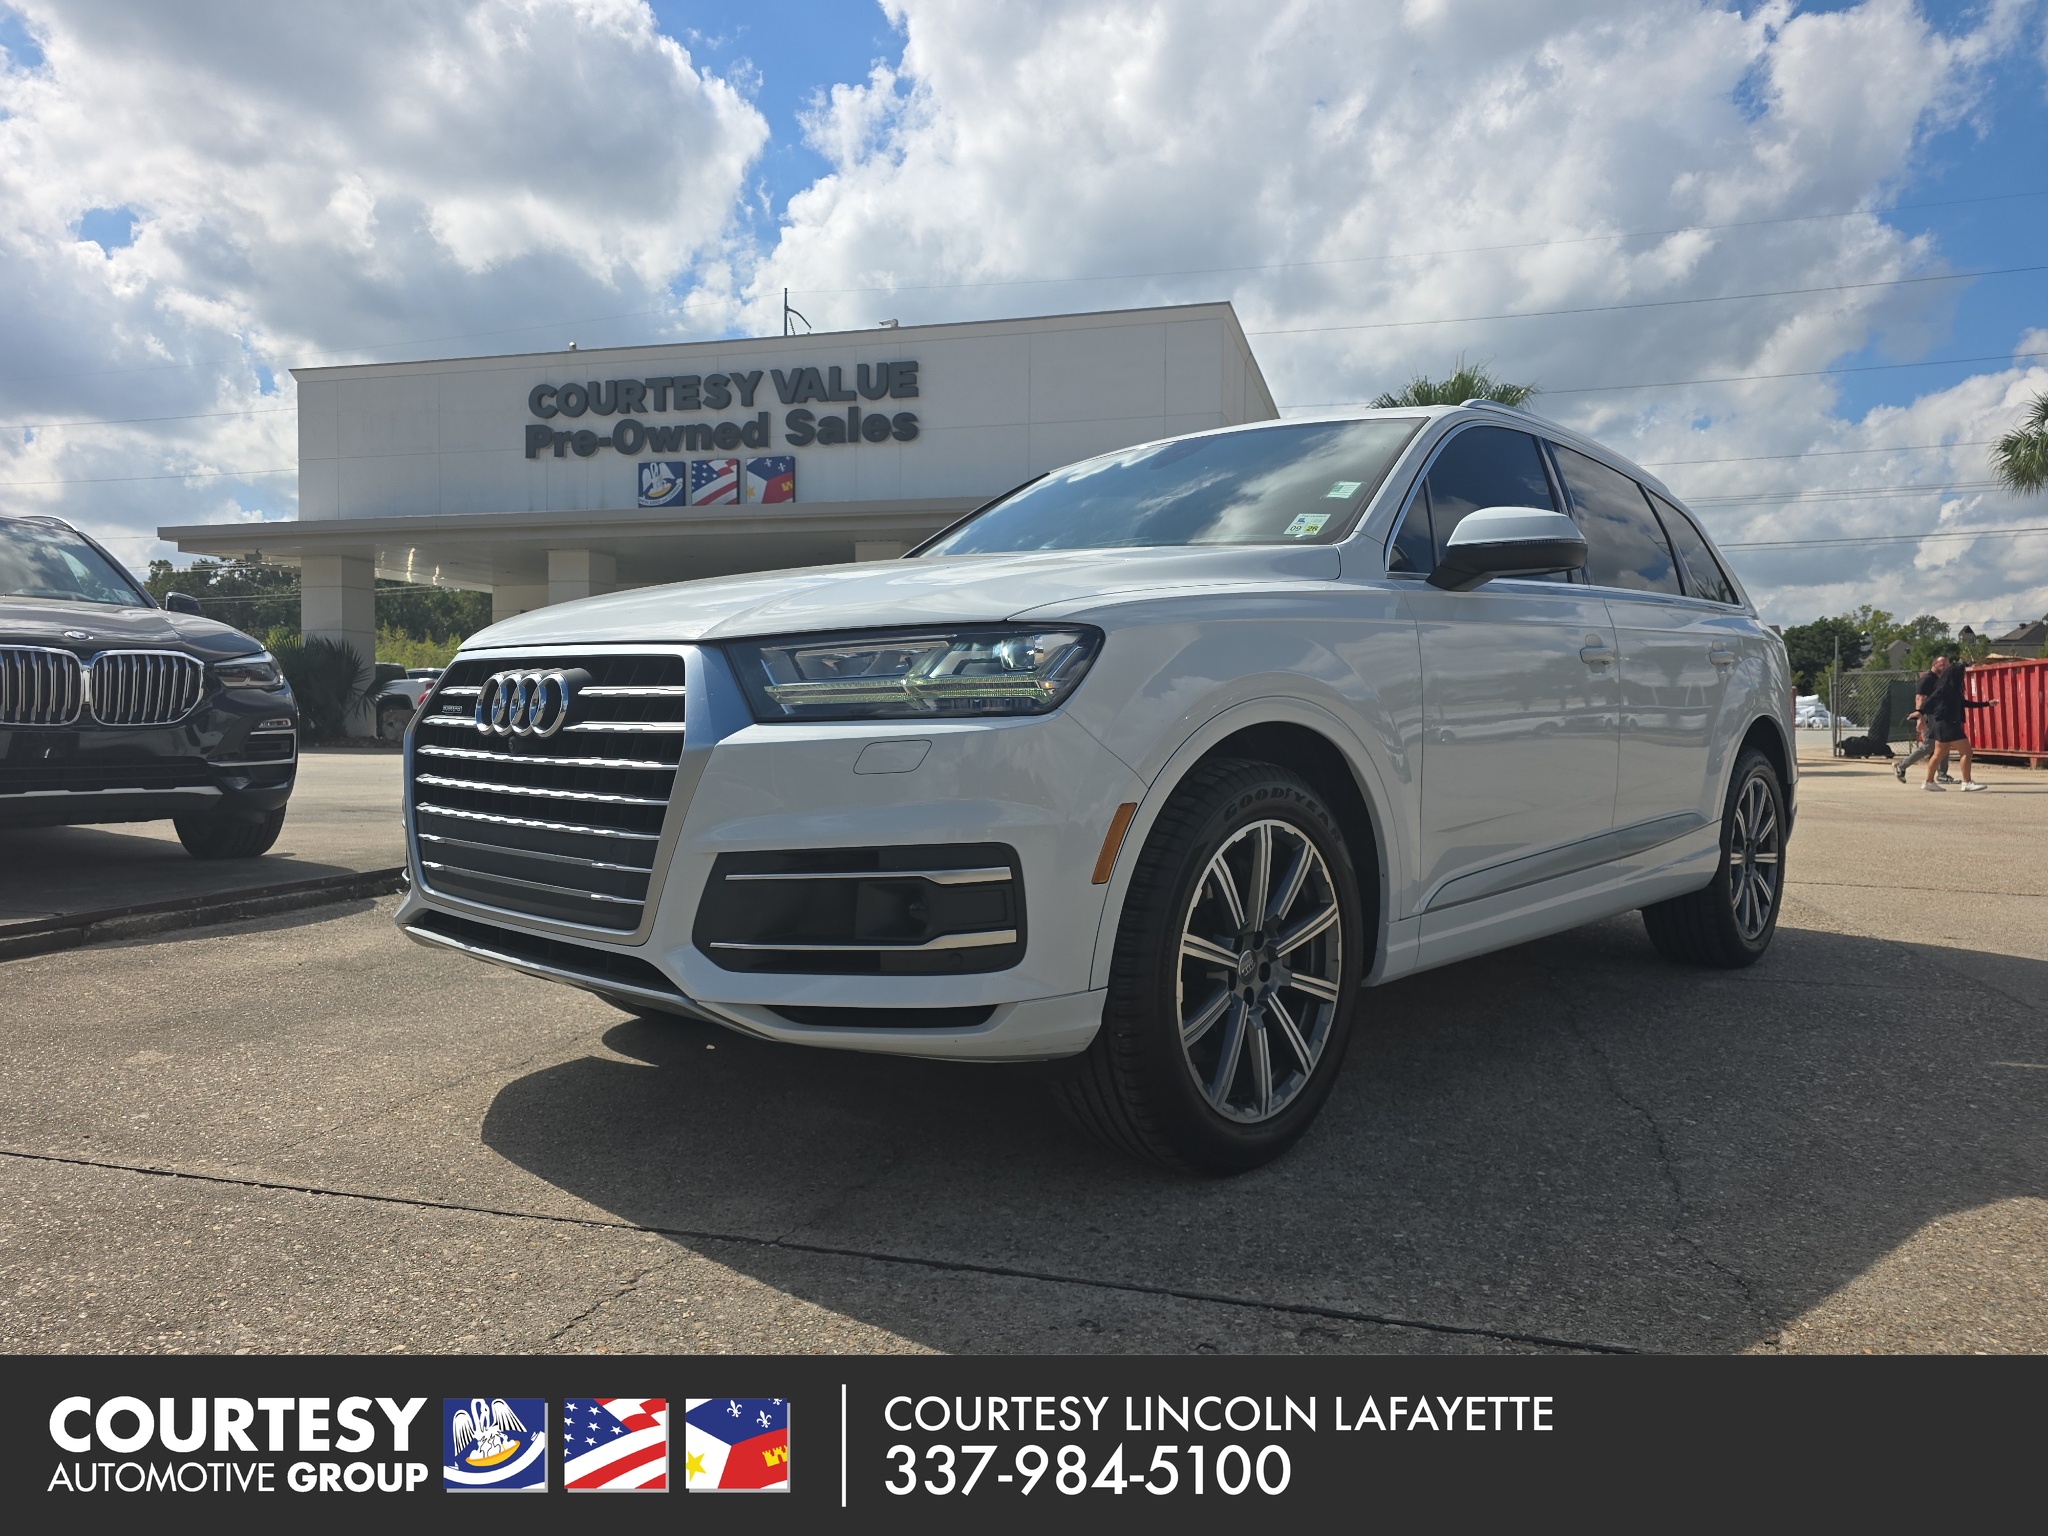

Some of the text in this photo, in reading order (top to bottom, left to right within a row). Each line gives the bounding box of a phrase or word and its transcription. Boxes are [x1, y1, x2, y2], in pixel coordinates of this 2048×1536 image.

[528, 361, 919, 419] COURTESY VALUE
[525, 406, 920, 459] Pre-Owned Sales
[1223, 787, 1341, 842] GOODYEAR
